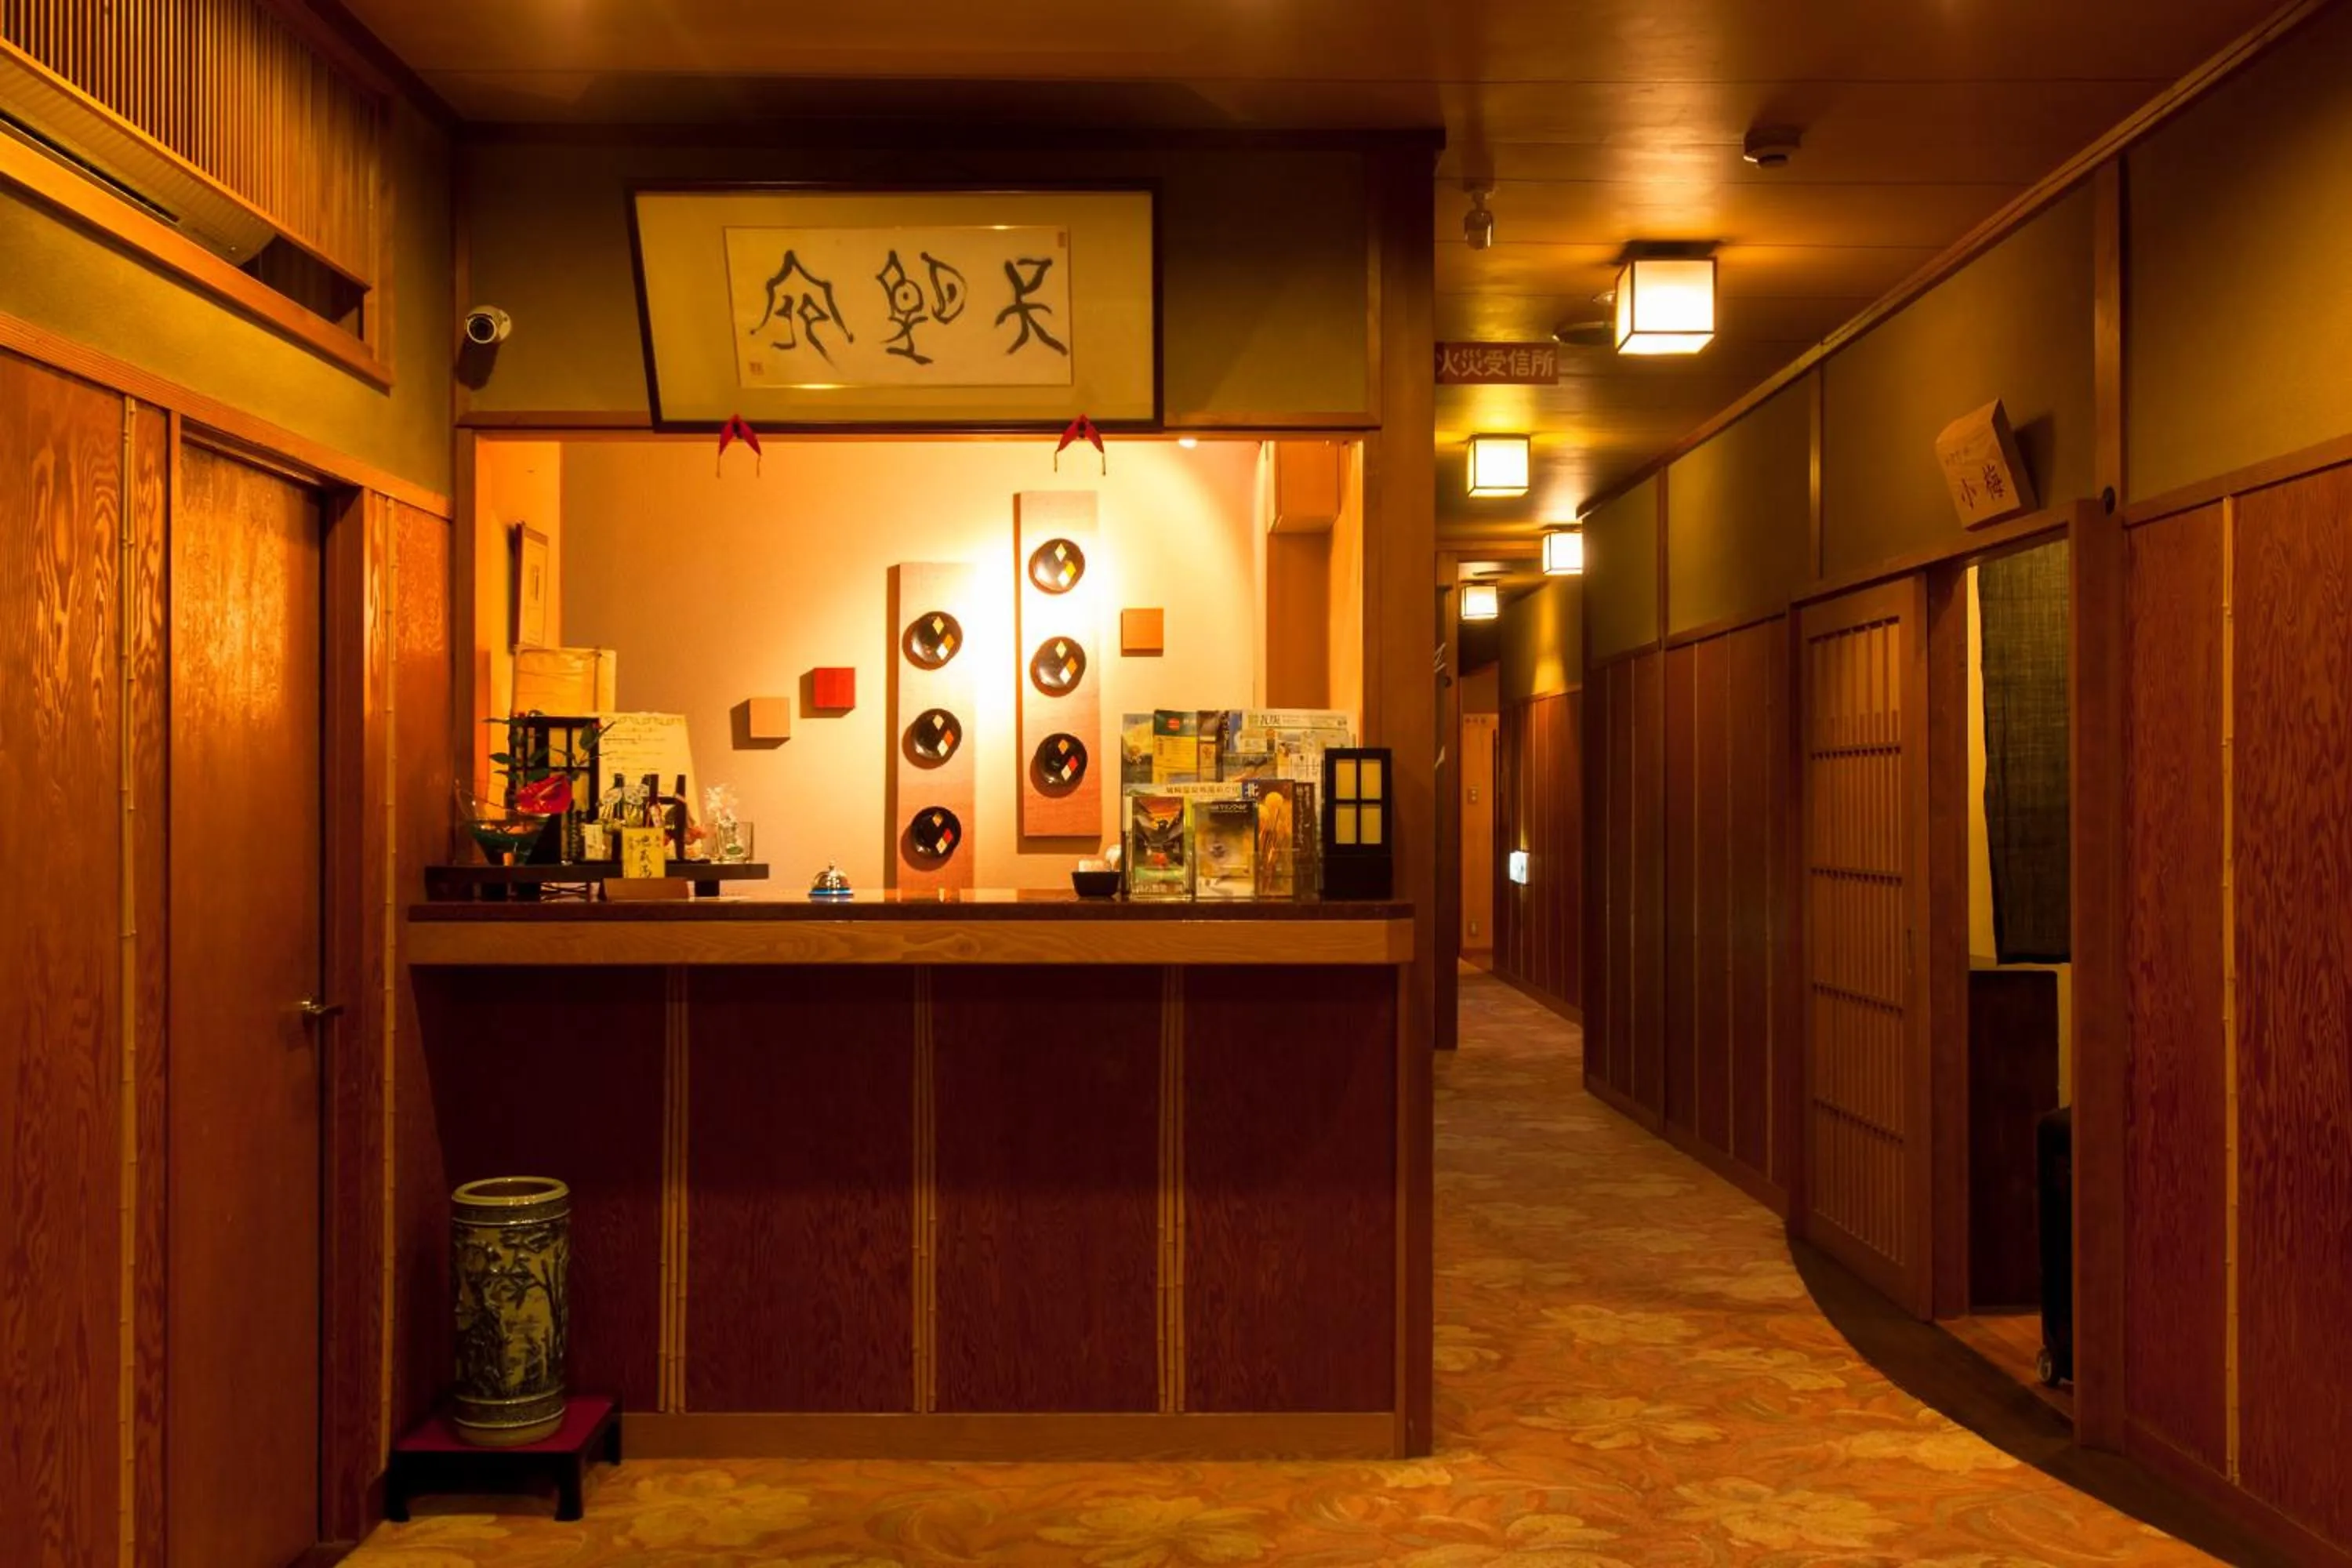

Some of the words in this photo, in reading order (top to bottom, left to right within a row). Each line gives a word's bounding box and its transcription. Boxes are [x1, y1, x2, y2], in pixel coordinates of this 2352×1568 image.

[1436, 348, 1555, 377] 火災受信所
